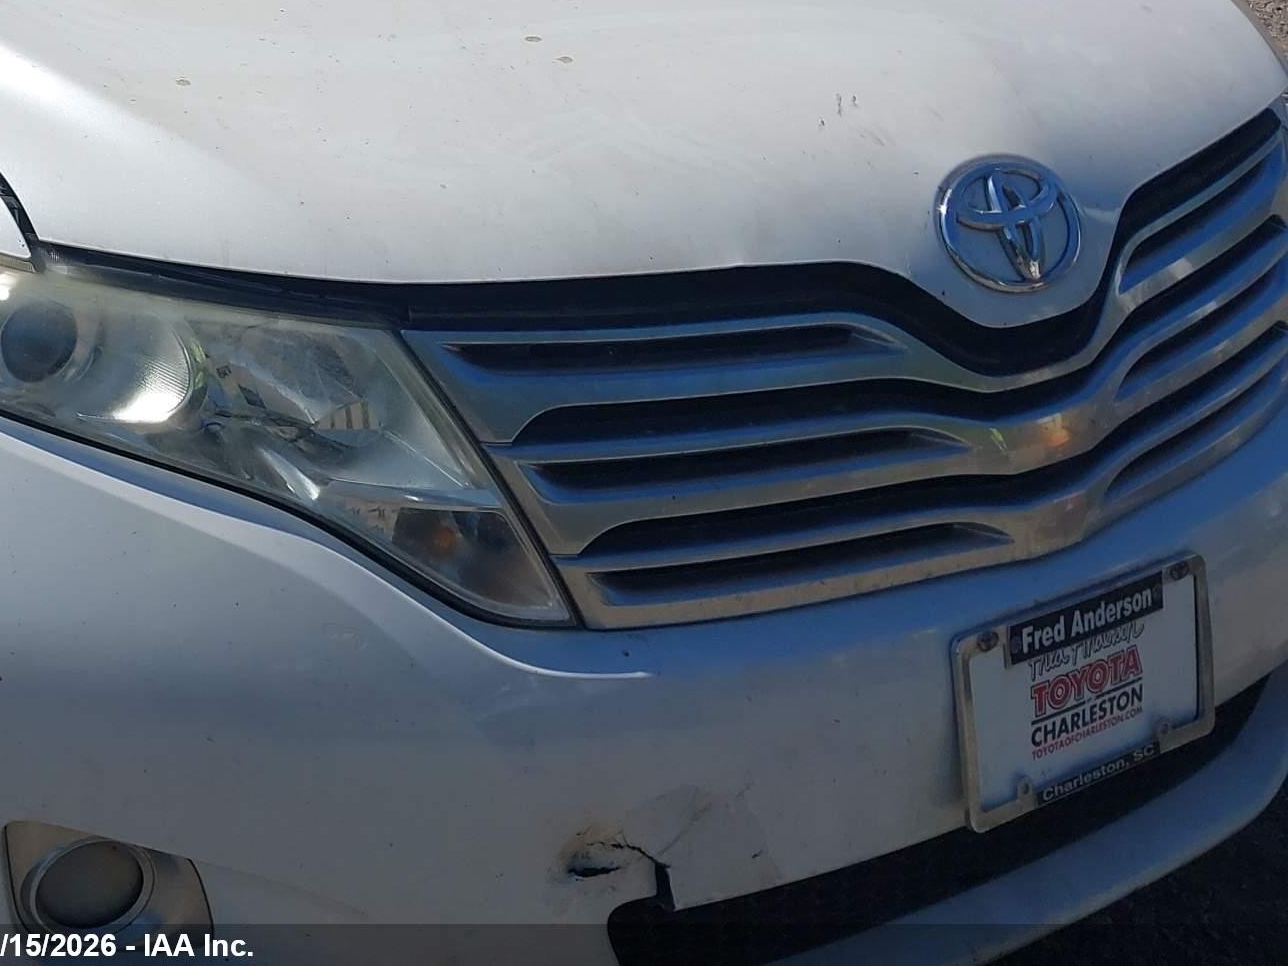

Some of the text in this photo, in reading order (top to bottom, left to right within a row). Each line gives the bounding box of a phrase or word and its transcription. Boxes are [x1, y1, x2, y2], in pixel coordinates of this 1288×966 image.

[1022, 615, 1065, 654] Fred
[1071, 588, 1152, 637] Anderson
[1030, 644, 1144, 718] TOYOTA
[1030, 683, 1144, 748] CHARLESTON
[1031, 705, 1144, 761] TOYOTAOFCHARLESTON.COM
[1042, 745, 1155, 802] Charleston, SC
